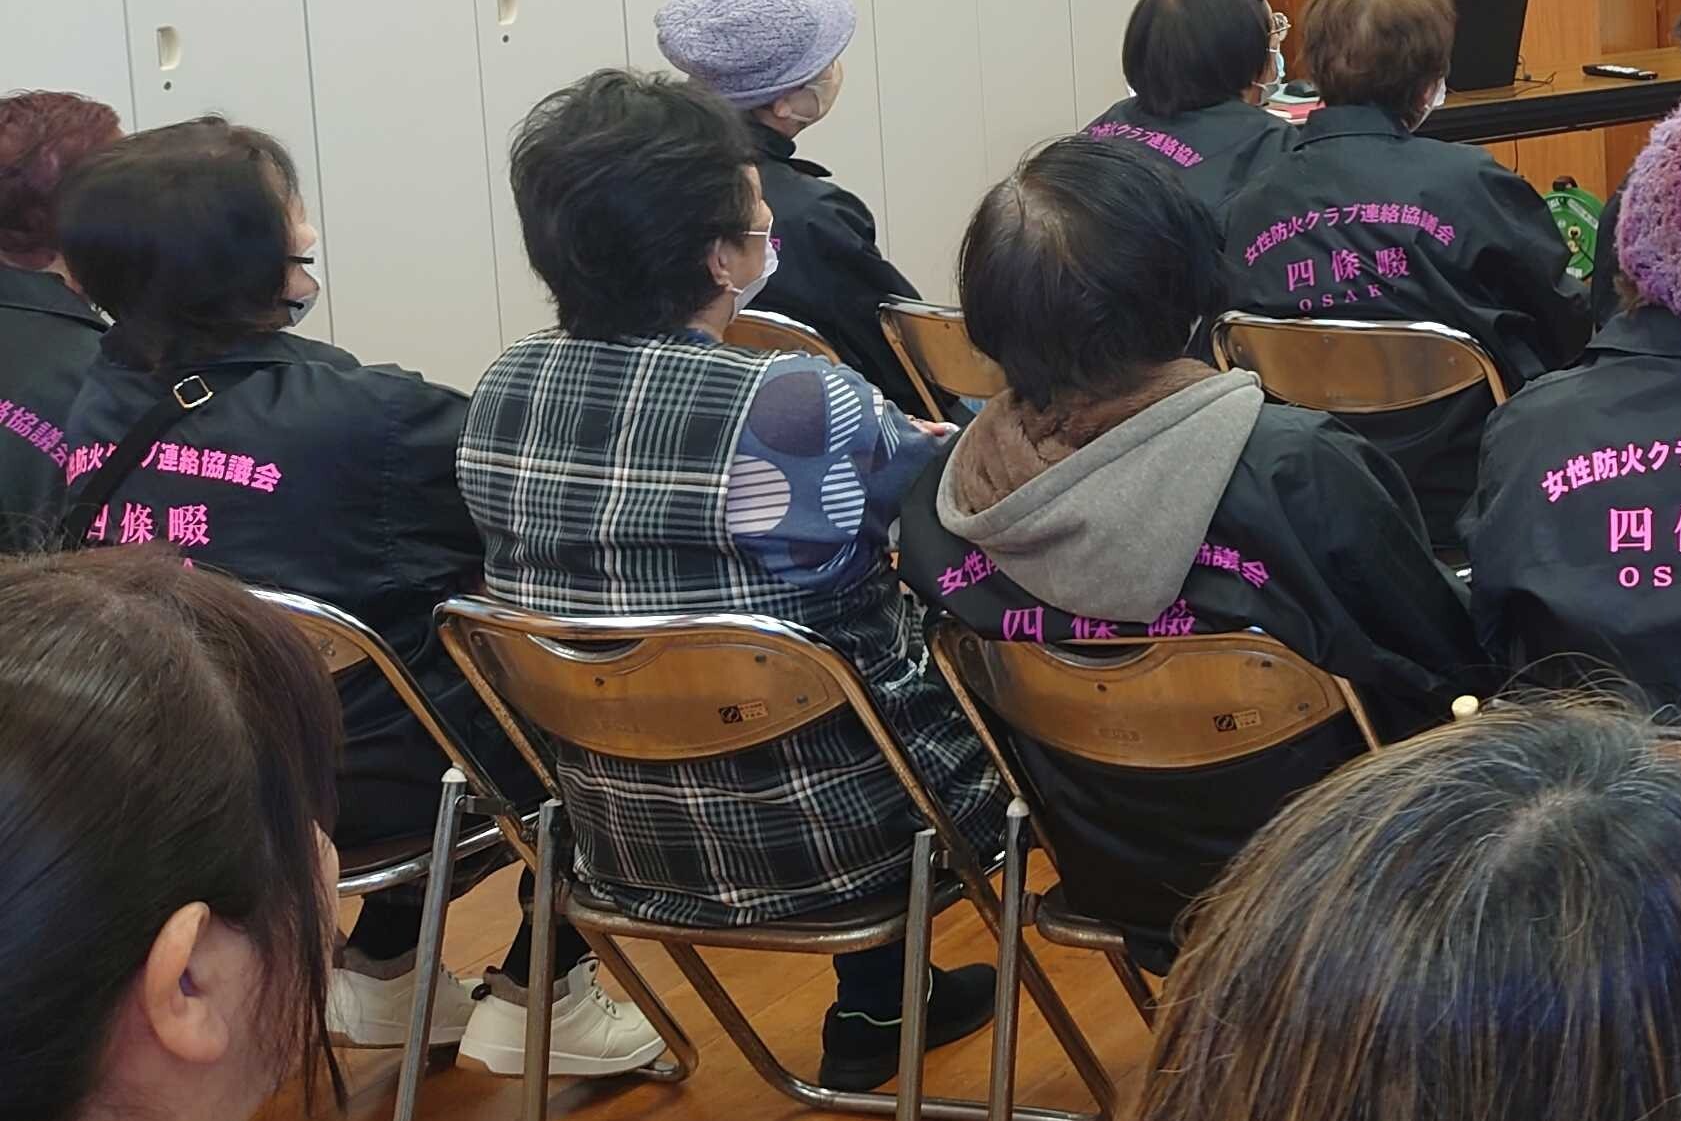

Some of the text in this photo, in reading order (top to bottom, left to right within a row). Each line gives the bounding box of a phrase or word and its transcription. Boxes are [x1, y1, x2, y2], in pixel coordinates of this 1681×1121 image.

[1245, 202, 1456, 267] 女性防火クラブ連絡協議会
[1299, 284, 1397, 312] OSAK
